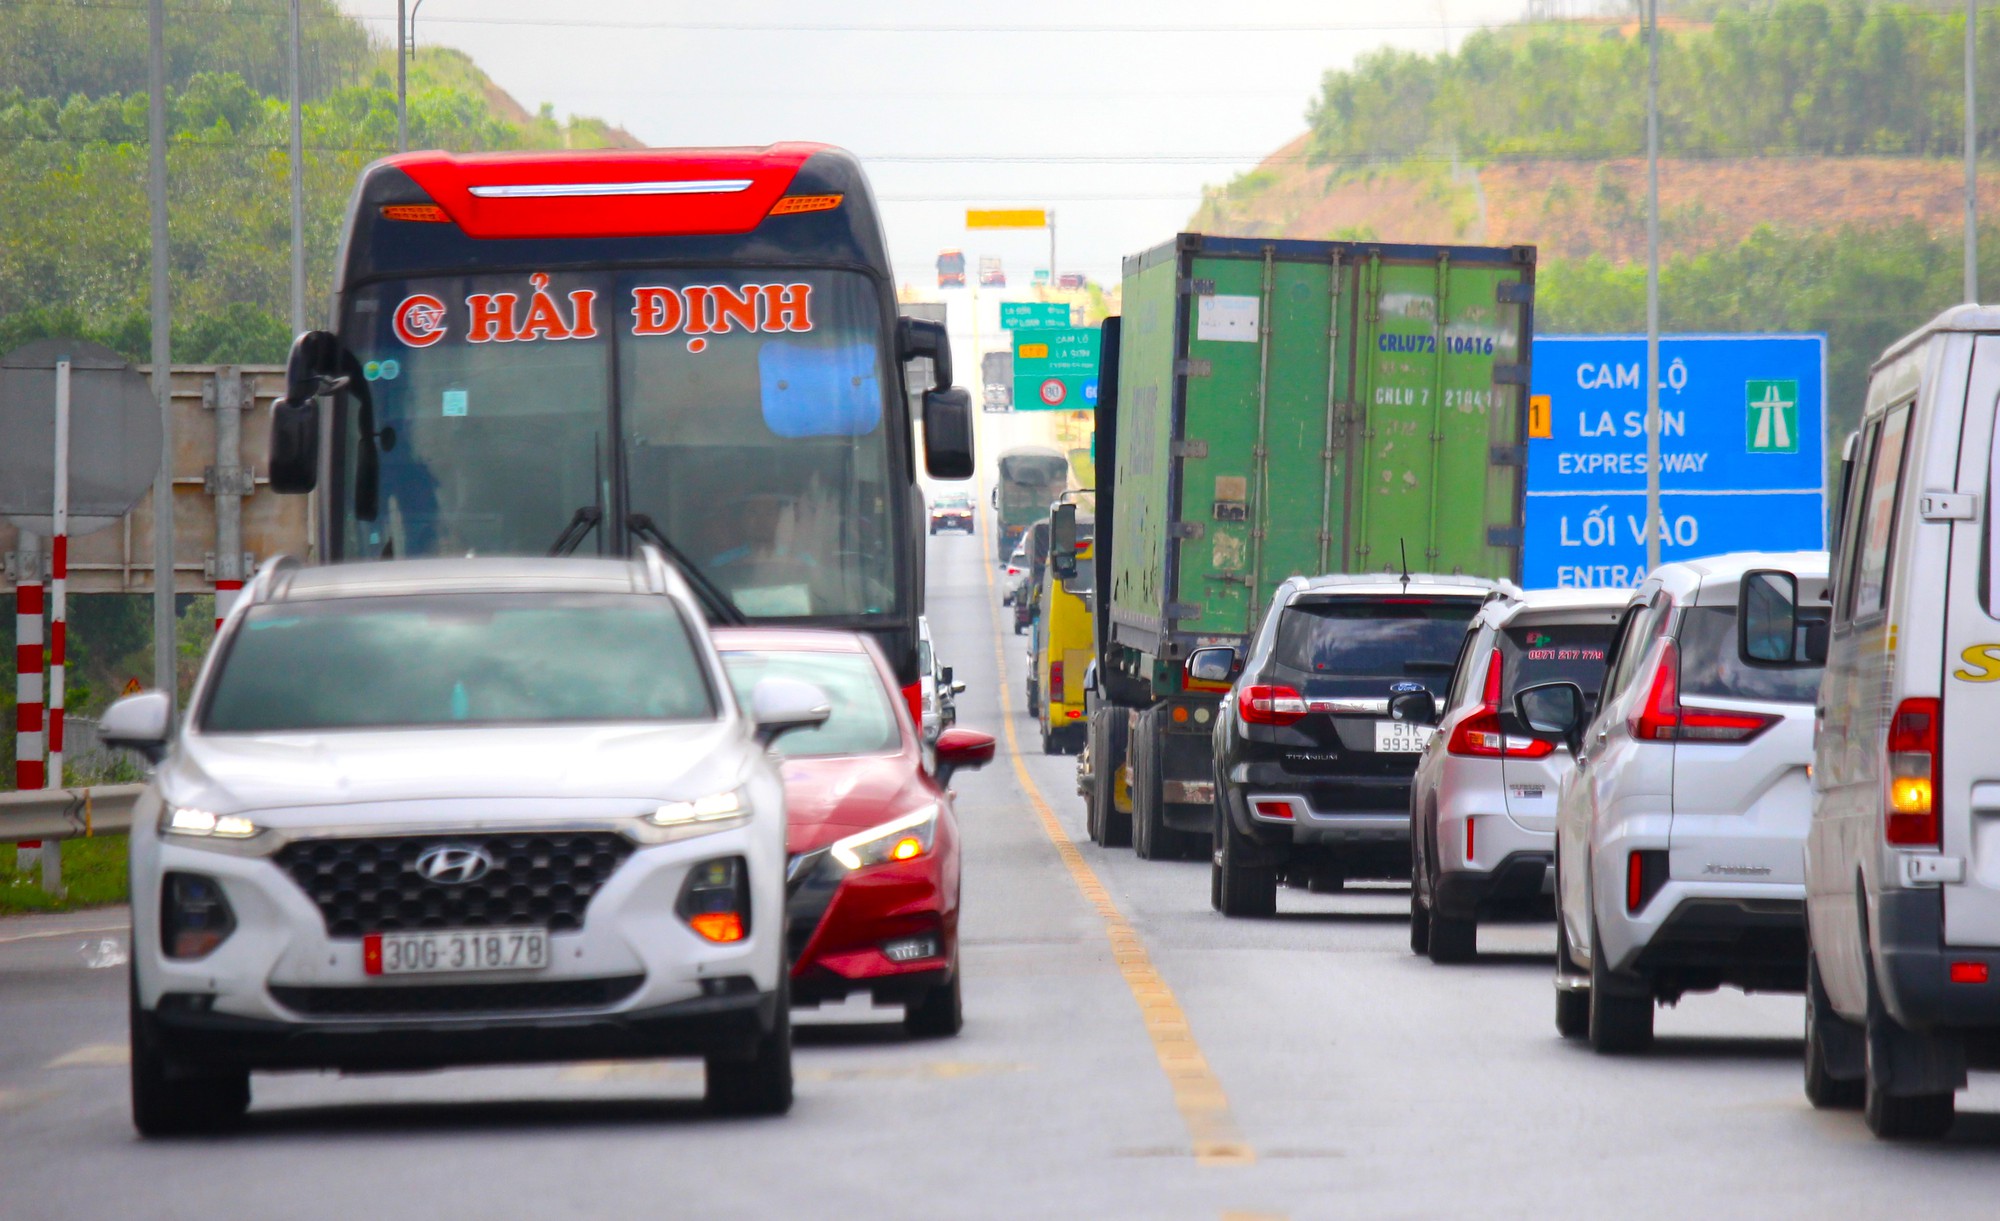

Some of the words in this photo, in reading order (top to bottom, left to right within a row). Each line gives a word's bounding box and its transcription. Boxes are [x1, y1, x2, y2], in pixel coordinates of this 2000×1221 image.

[465, 272, 598, 343] HẢI
[631, 283, 813, 353] ĐỊNH
[1576, 362, 1641, 390] CAM
[1578, 410, 1617, 437] LA
[1557, 451, 1708, 475] EXPRESWAY
[1559, 504, 1616, 547] LỐI
[386, 935, 543, 971] 30G-318.78
